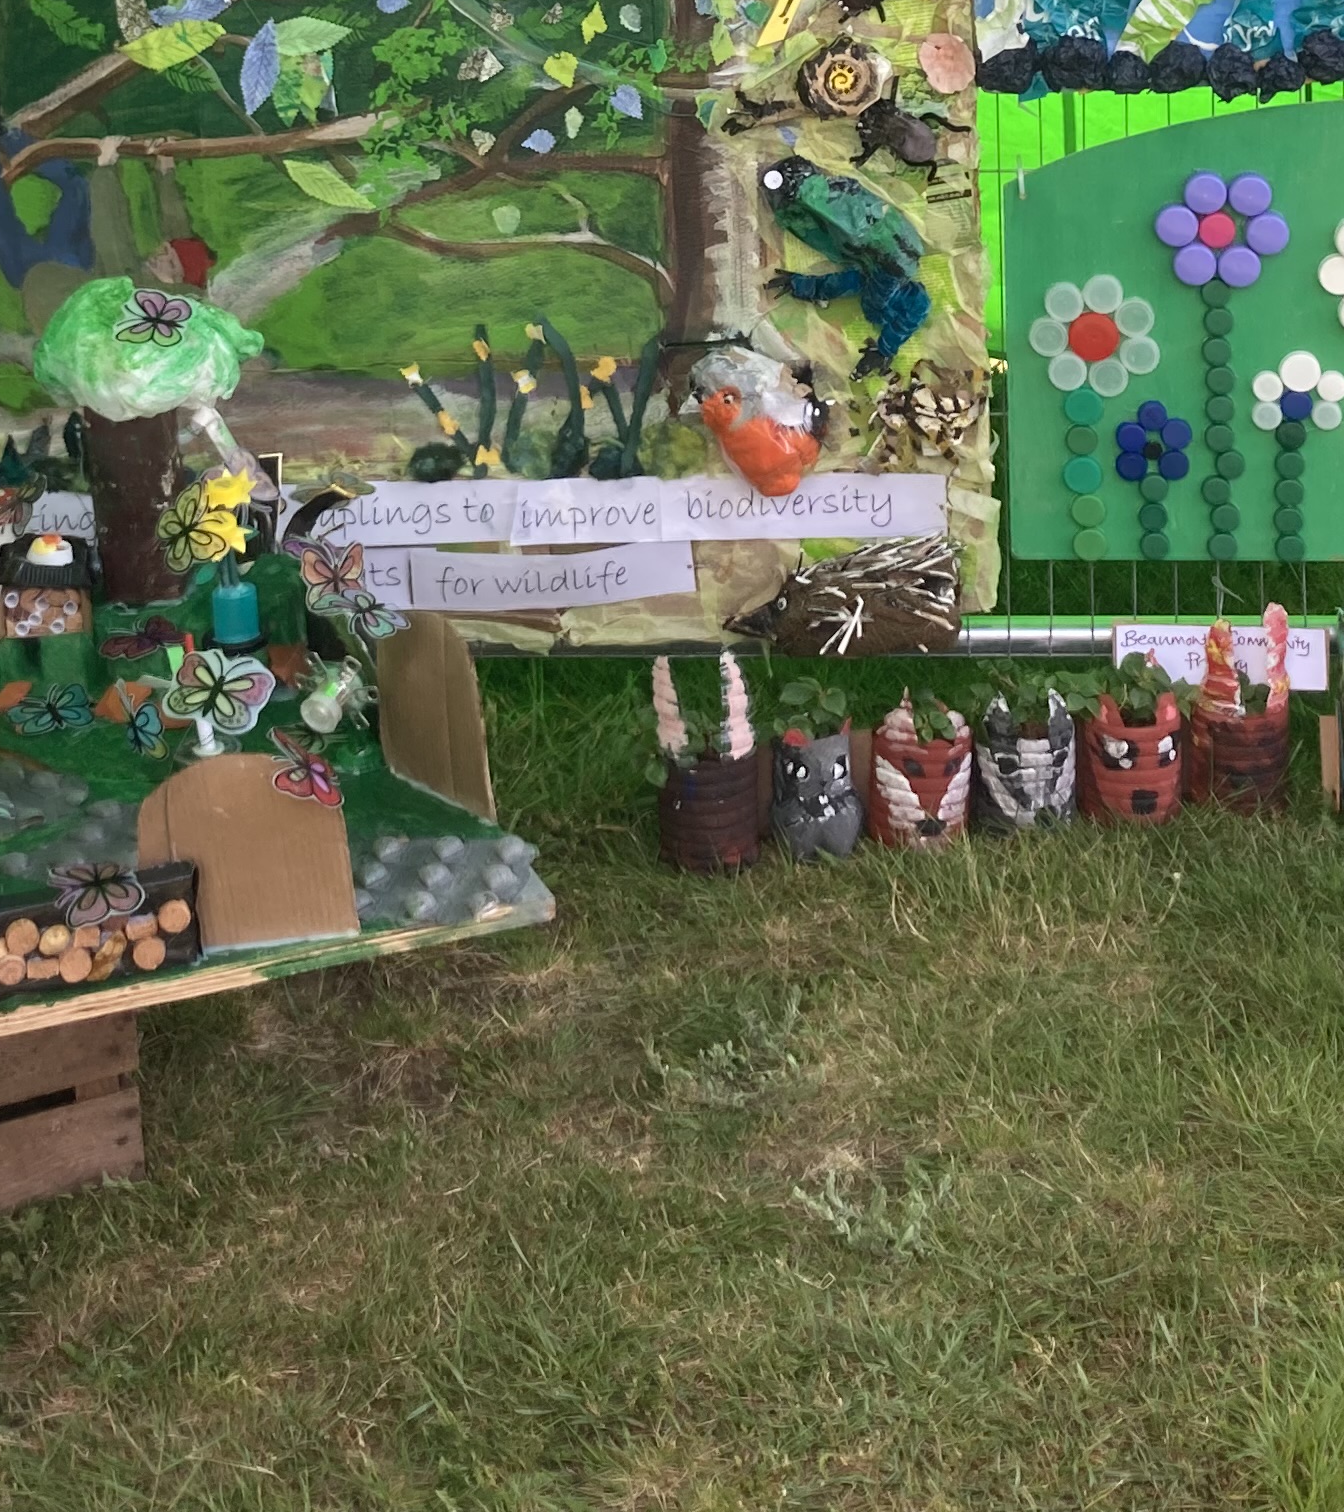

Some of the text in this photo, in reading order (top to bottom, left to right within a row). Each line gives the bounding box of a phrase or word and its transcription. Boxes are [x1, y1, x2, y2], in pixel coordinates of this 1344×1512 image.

[462, 496, 495, 524] to
[520, 497, 658, 534] improve
[686, 484, 893, 528] biodiversity
[435, 565, 485, 604] for
[494, 559, 630, 596] wildlife
